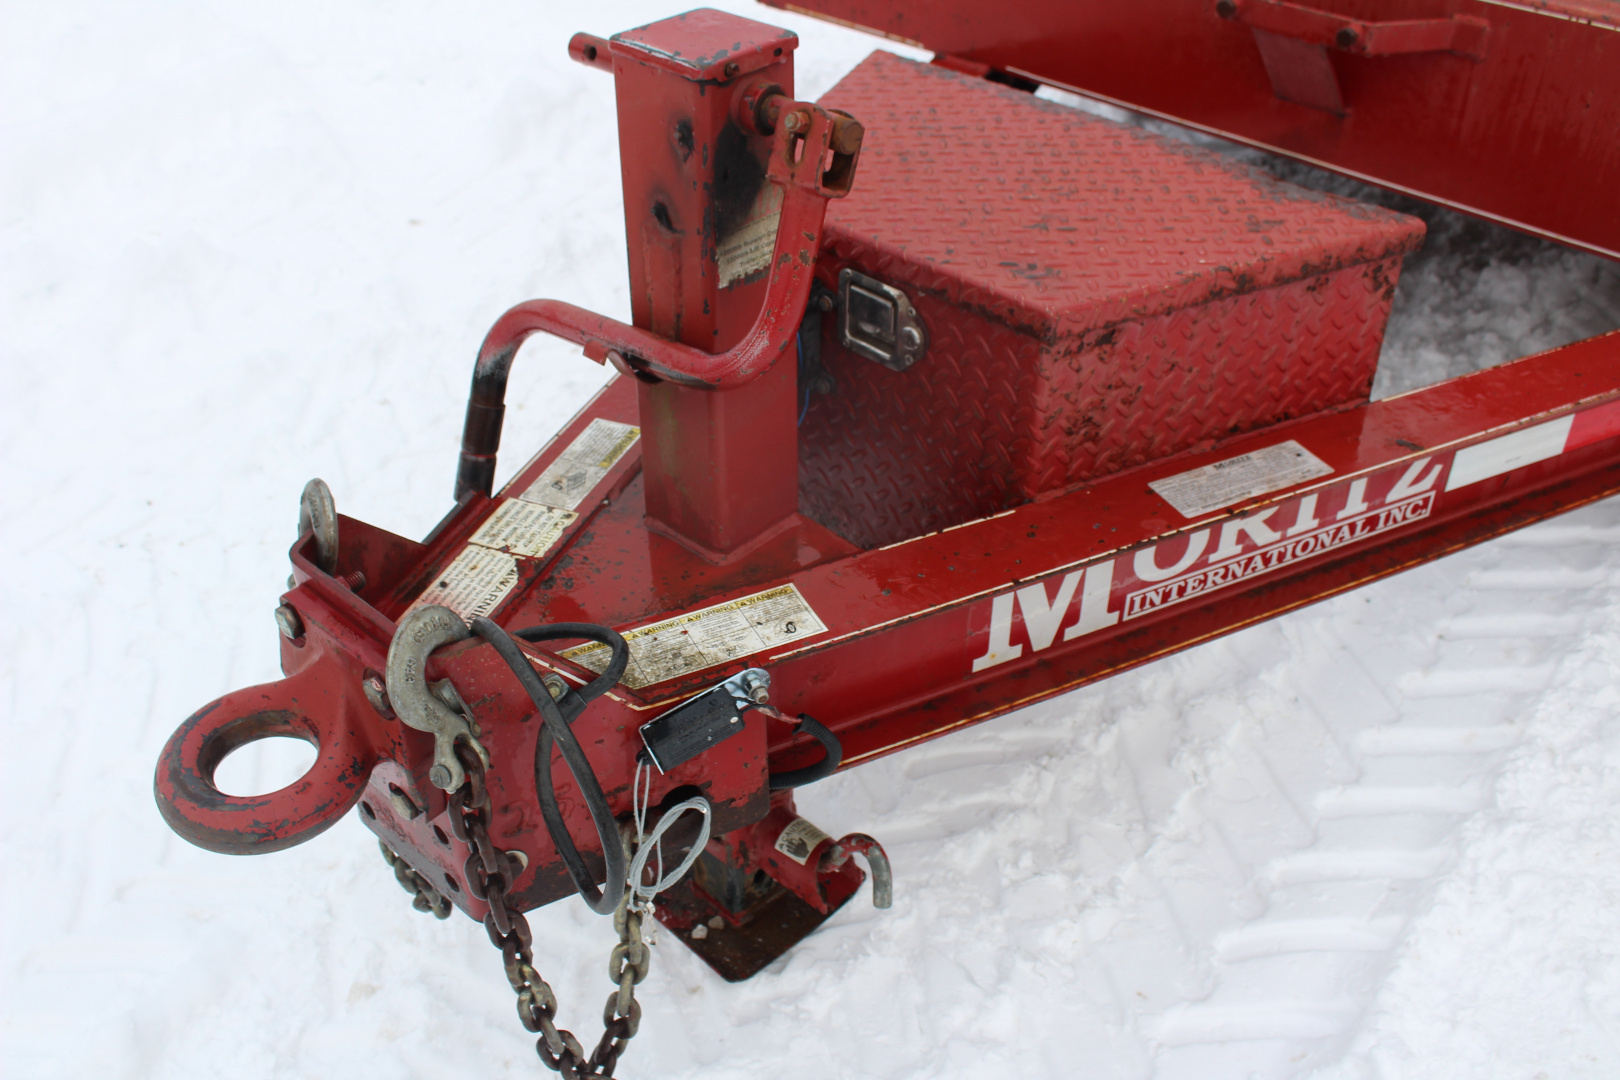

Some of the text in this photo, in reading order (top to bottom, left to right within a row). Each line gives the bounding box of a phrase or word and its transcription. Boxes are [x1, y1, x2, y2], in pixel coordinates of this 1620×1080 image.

[529, 520, 566, 554] CAUTION
[1131, 499, 1427, 614] INTERNATIONAL INC.
[748, 587, 787, 606] WARNING
[693, 604, 734, 620] WARNING
[640, 620, 680, 636] WARNING
